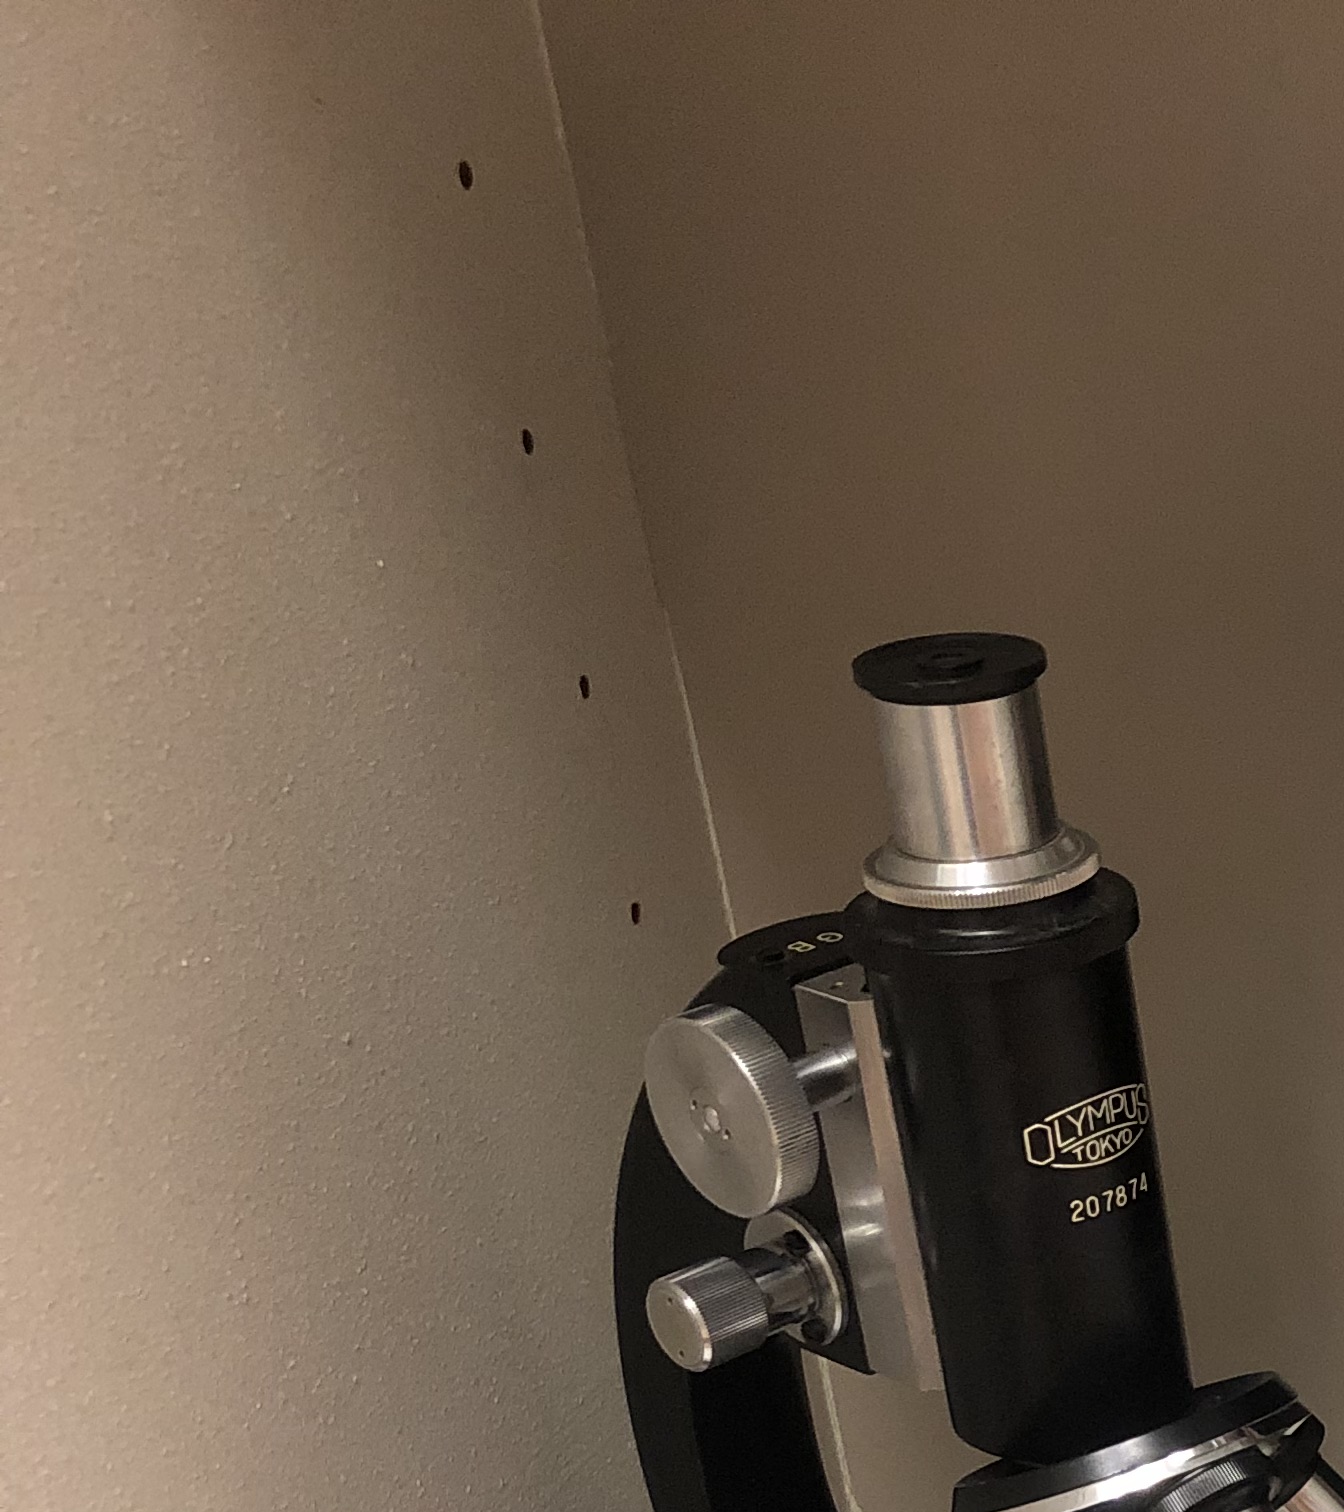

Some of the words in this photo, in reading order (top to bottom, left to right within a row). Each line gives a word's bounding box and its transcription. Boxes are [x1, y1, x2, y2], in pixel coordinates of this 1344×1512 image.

[1023, 1082, 1150, 1166] OLYMPUS
[1071, 1127, 1133, 1162] TOKYO
[1069, 1171, 1148, 1223] 207874
